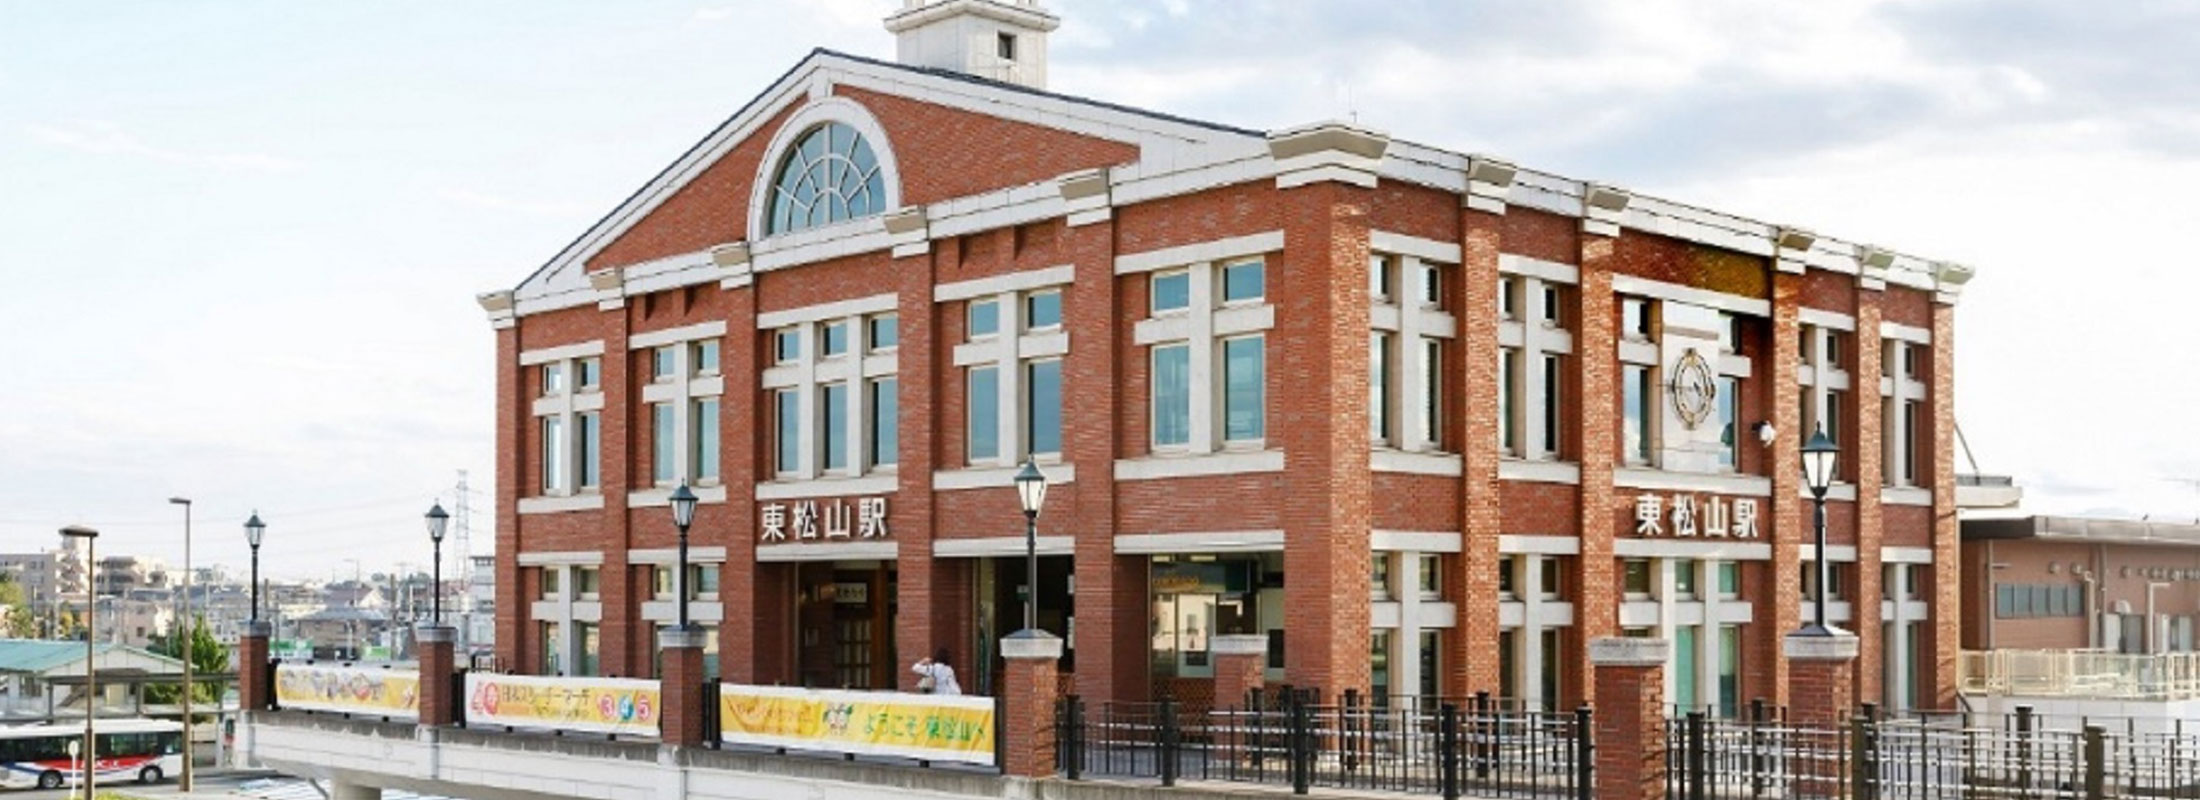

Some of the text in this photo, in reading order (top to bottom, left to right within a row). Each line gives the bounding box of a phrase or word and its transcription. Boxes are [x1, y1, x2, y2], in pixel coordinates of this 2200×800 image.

[761, 498, 886, 541] 東松山駅
[1636, 493, 1758, 537] 東松山駅
[865, 711, 917, 737] ようこそ
